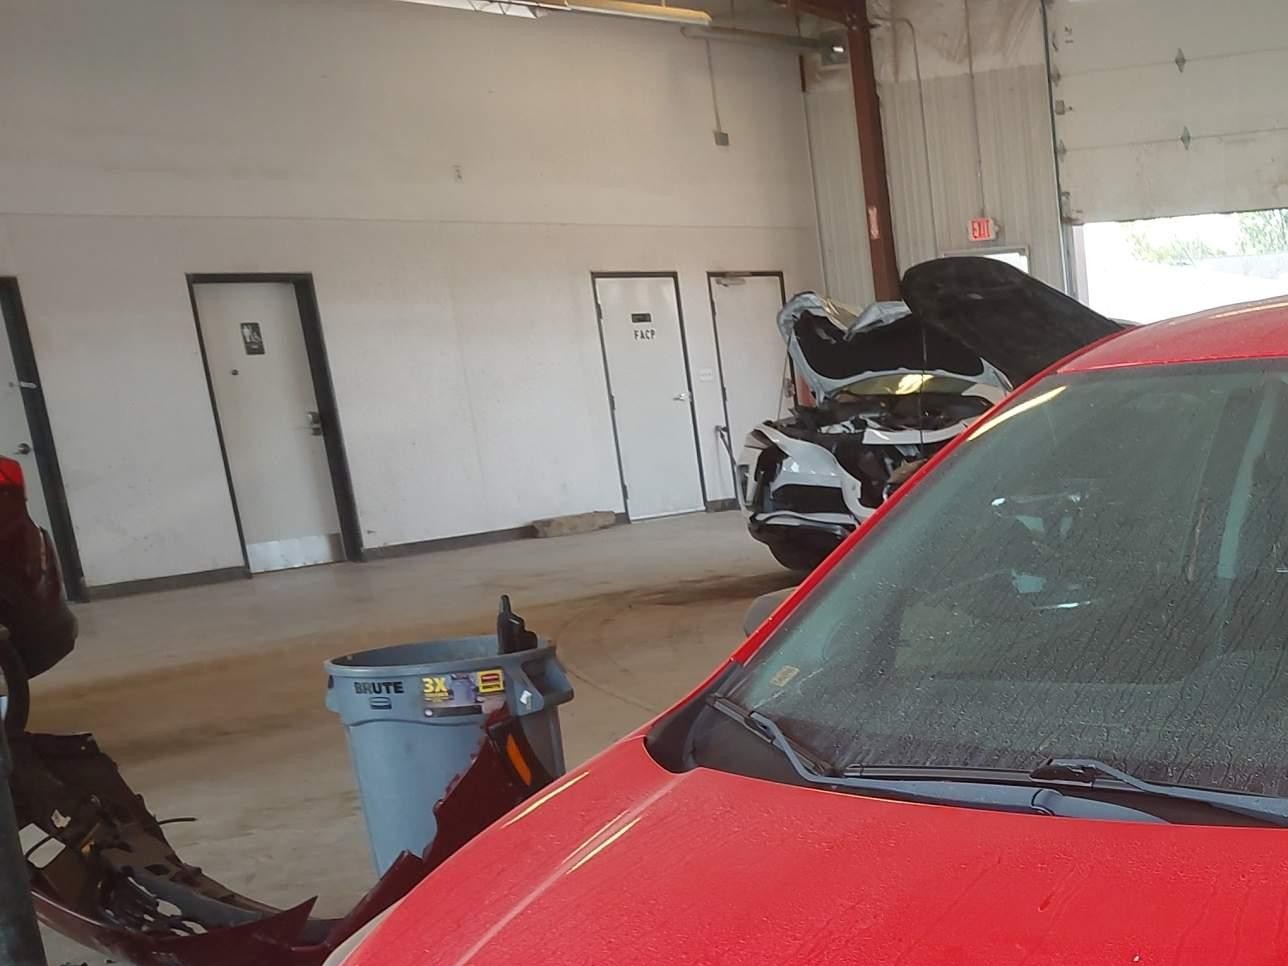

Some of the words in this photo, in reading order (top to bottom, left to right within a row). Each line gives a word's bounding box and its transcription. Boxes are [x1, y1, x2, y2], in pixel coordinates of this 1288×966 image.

[634, 329, 656, 341] FACP
[354, 681, 405, 695] BRUTE
[422, 676, 448, 693] 3X
